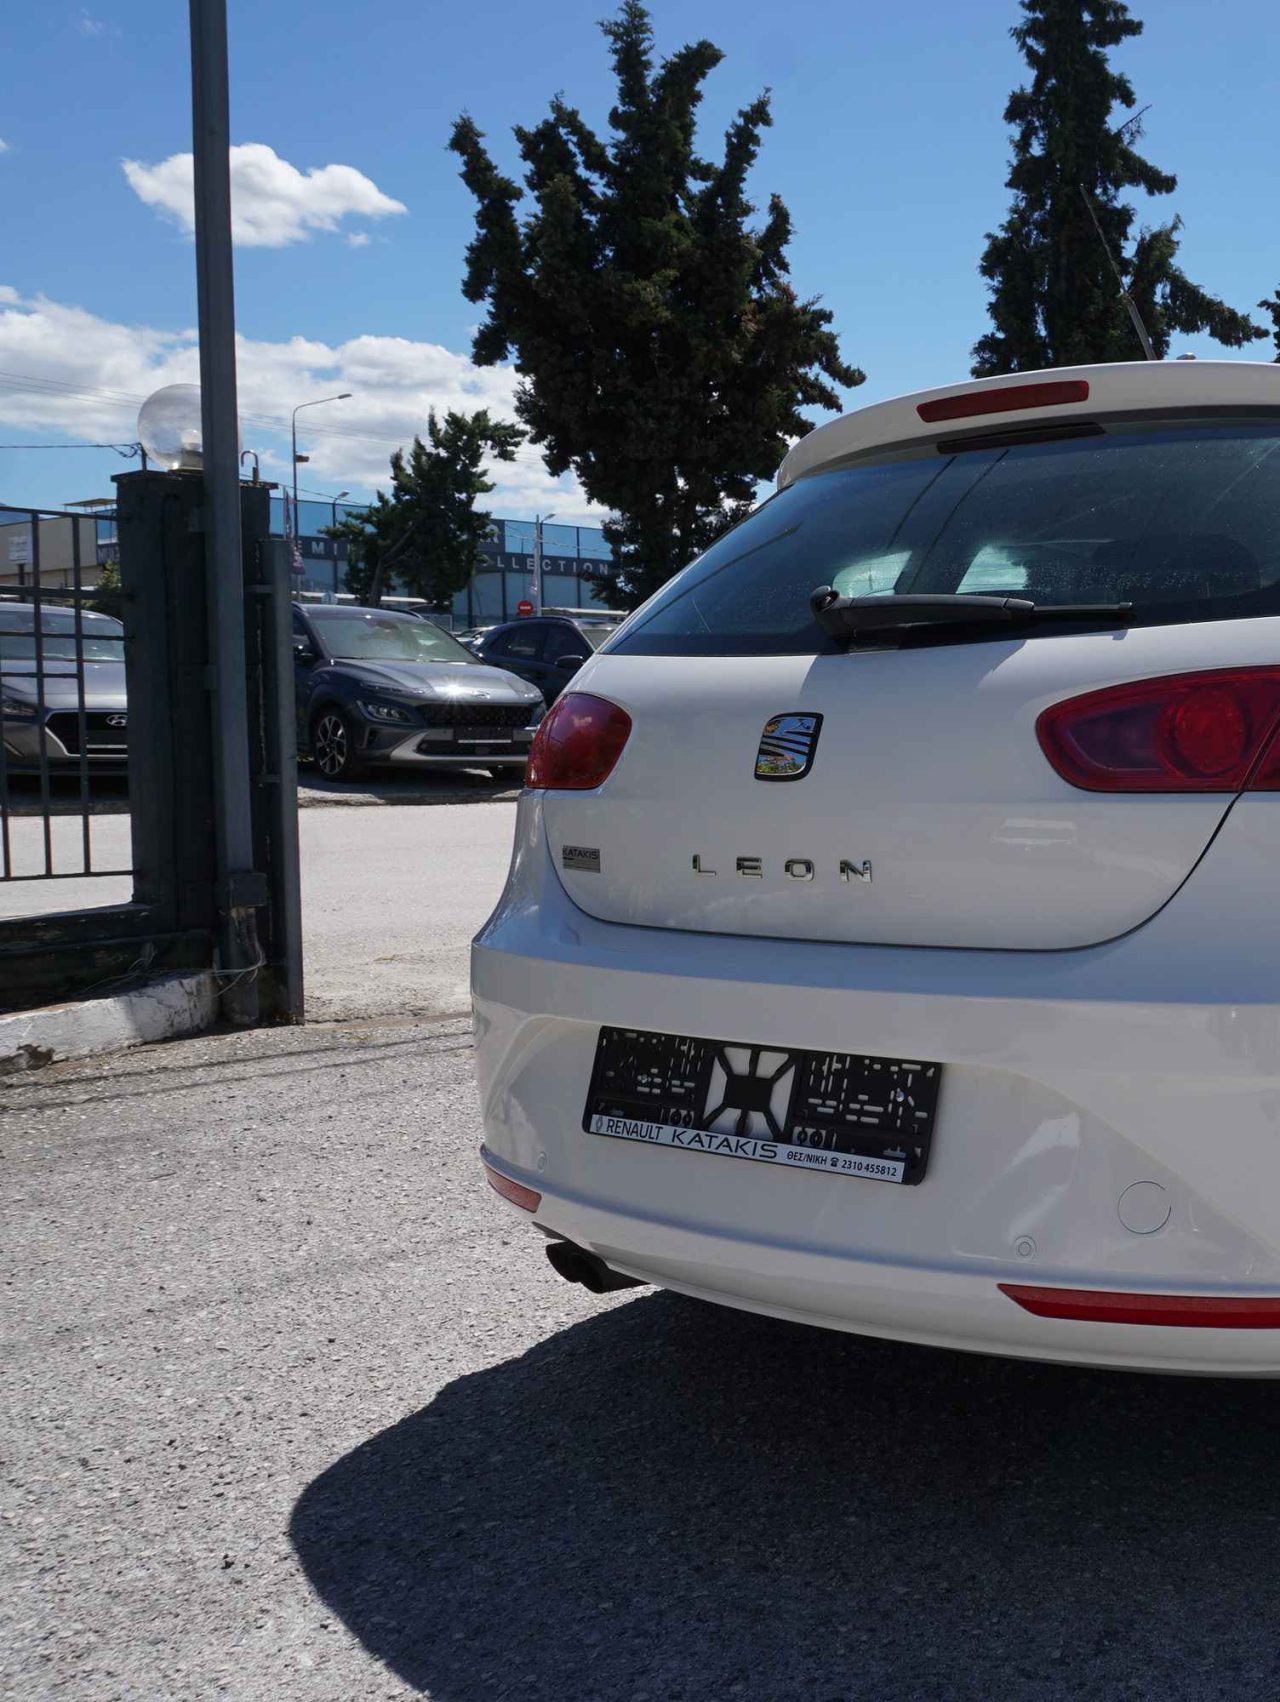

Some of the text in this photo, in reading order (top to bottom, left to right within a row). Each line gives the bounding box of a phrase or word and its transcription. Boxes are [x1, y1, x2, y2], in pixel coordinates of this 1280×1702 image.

[562, 847, 600, 860] KATAKIS
[691, 853, 874, 884] LEON
[606, 1118, 663, 1141] RENAULT
[671, 1128, 778, 1159] KATAKIS
[841, 1159, 863, 1171] 2310
[864, 1162, 897, 1177] 455812
